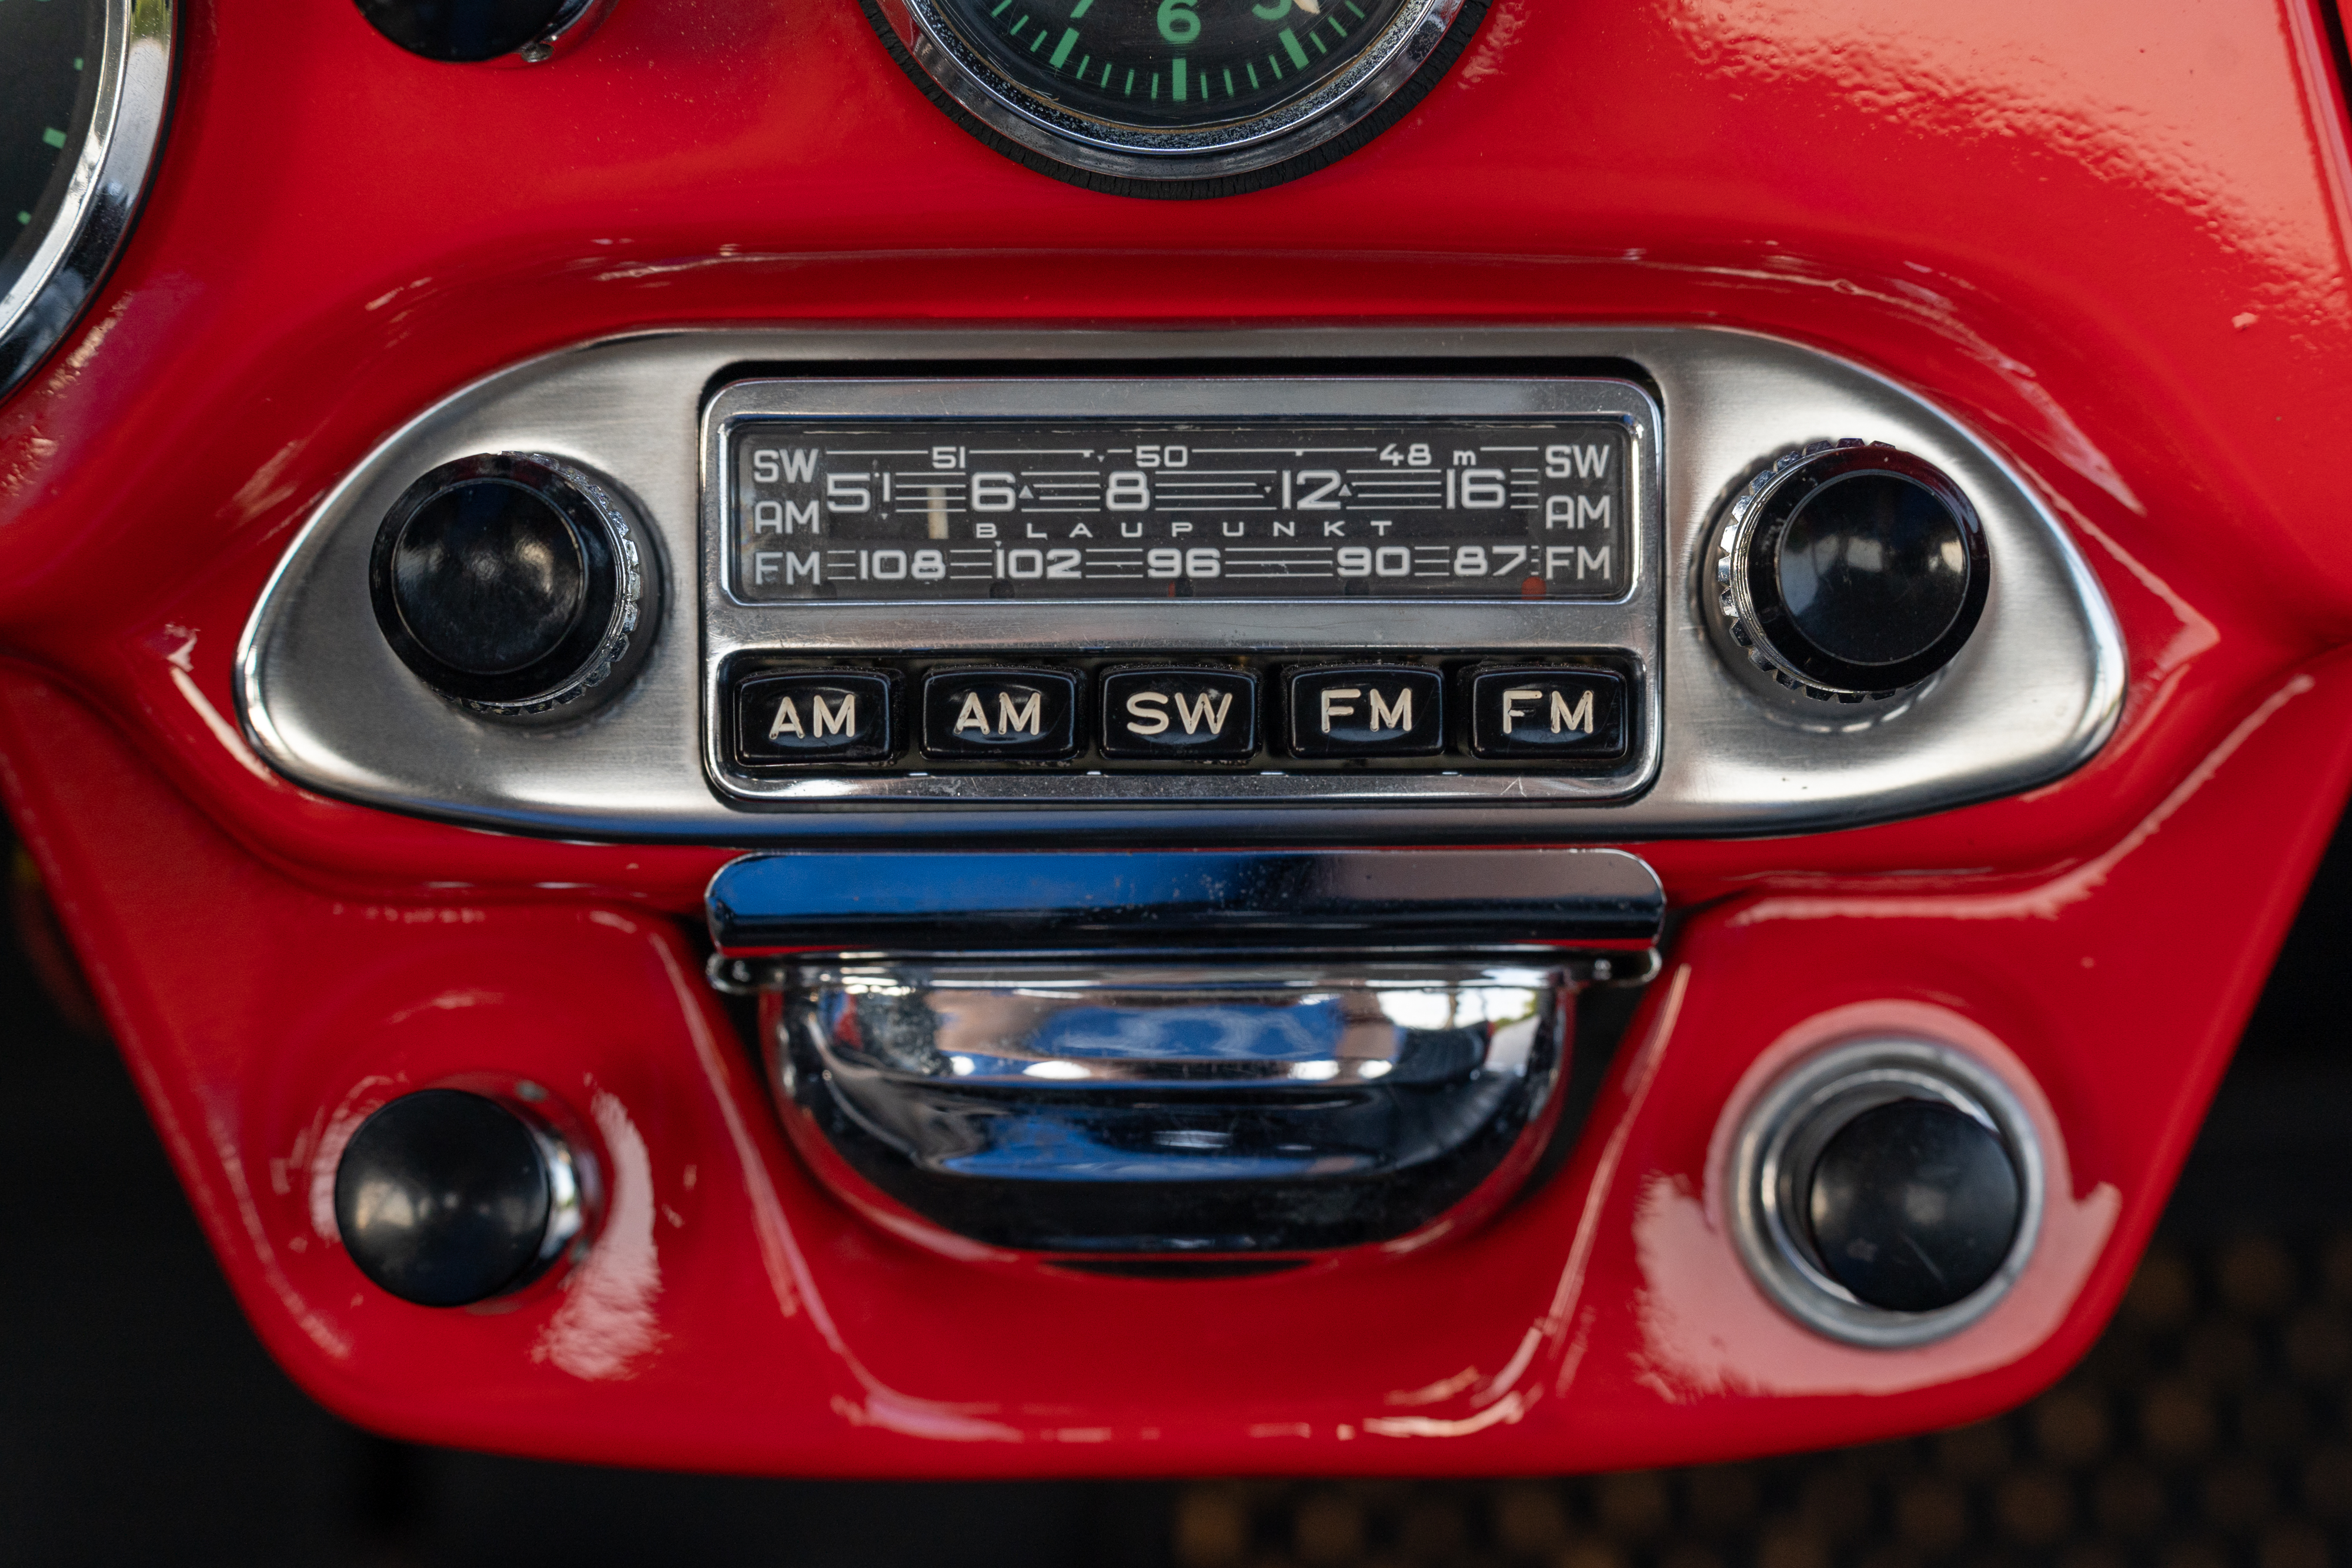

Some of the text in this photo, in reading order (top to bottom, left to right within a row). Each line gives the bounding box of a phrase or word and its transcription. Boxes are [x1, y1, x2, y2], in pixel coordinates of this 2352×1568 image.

[1157, 0, 1201, 45] 6
[754, 443, 1610, 483] SW 51 50 48 m SW
[754, 500, 820, 534] AM
[971, 472, 1016, 511] 6
[1105, 470, 1150, 511] 8
[1282, 470, 1341, 510] 12
[1446, 469, 1505, 509] 16
[1545, 495, 1611, 529] AM
[975, 521, 1392, 539] BLAUPUNKT
[755, 545, 1611, 585] FM 108 102 96 90 87 FM
[769, 695, 856, 740] AM
[953, 691, 1041, 735] AM
[1126, 691, 1232, 735] SW
[1321, 688, 1412, 734] FM
[1503, 690, 1593, 734] FM
